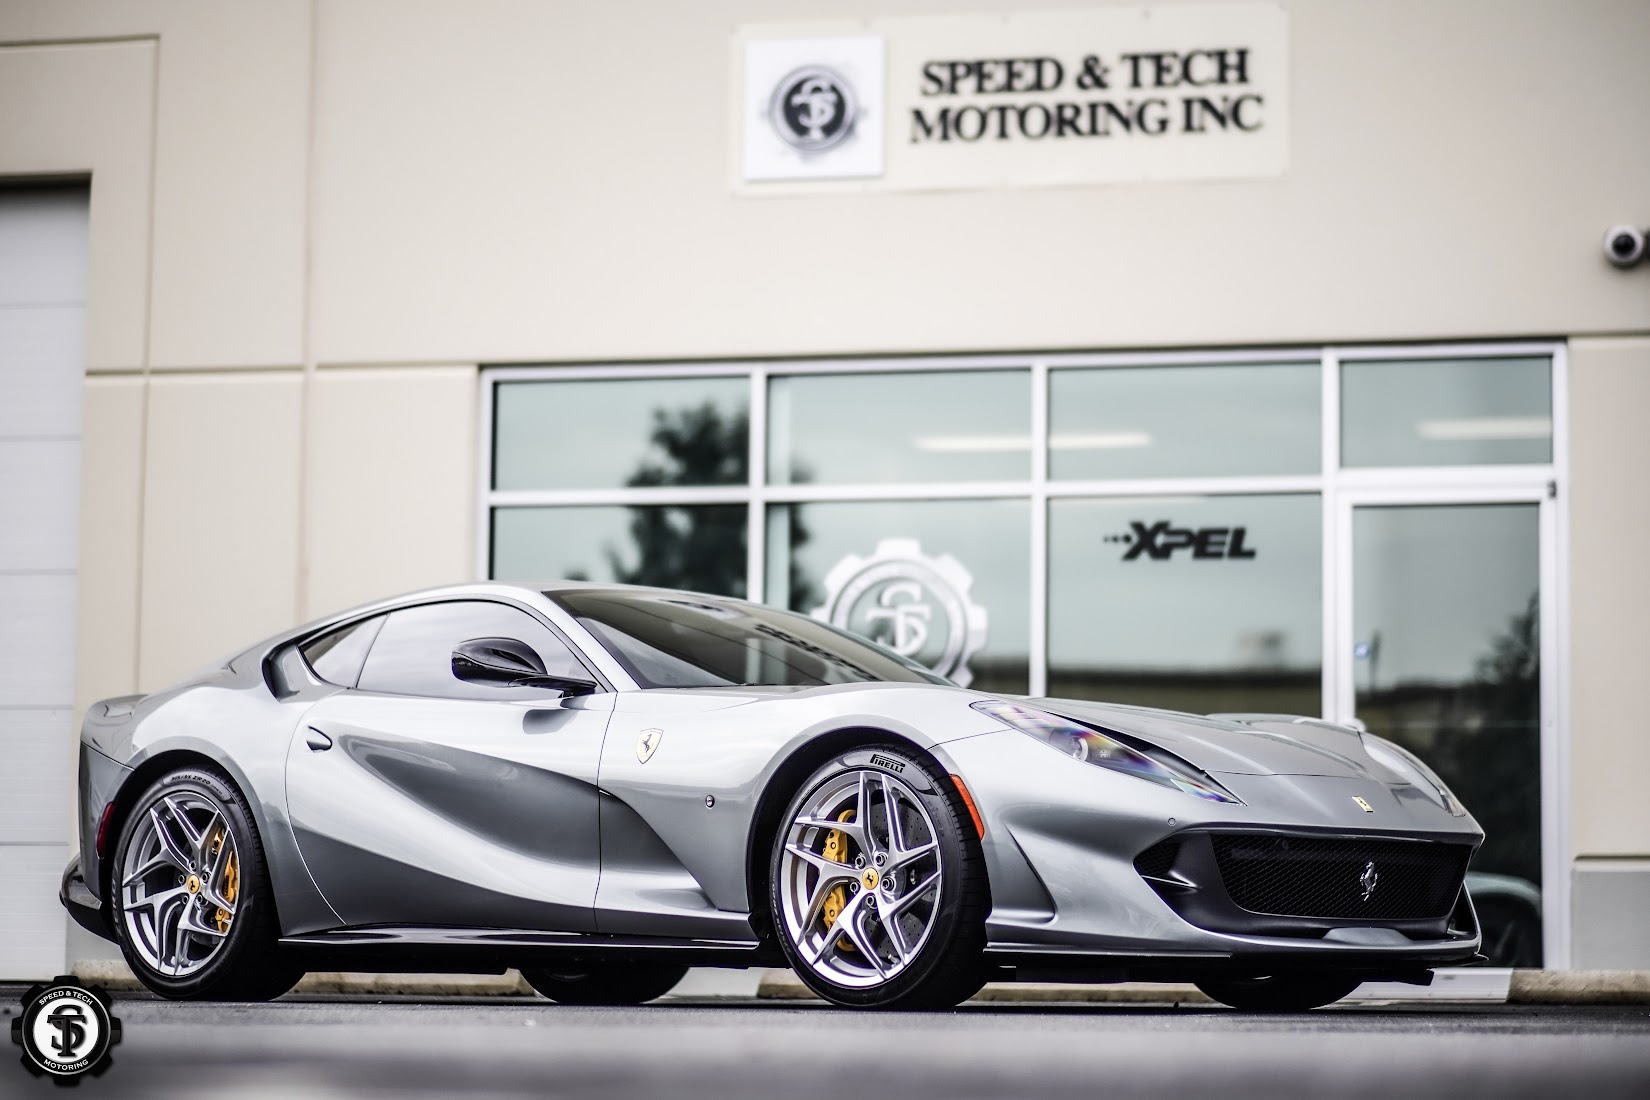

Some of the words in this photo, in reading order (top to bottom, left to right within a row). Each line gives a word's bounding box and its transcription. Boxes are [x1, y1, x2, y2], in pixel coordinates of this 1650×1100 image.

[920, 57, 1064, 97] SPEED
[1076, 54, 1110, 91] &
[1120, 48, 1250, 89] TECH
[910, 101, 1169, 144] MOTORING
[1181, 95, 1264, 133] INC
[1121, 520, 1257, 562] XPEL
[870, 753, 906, 774] PIRELLI
